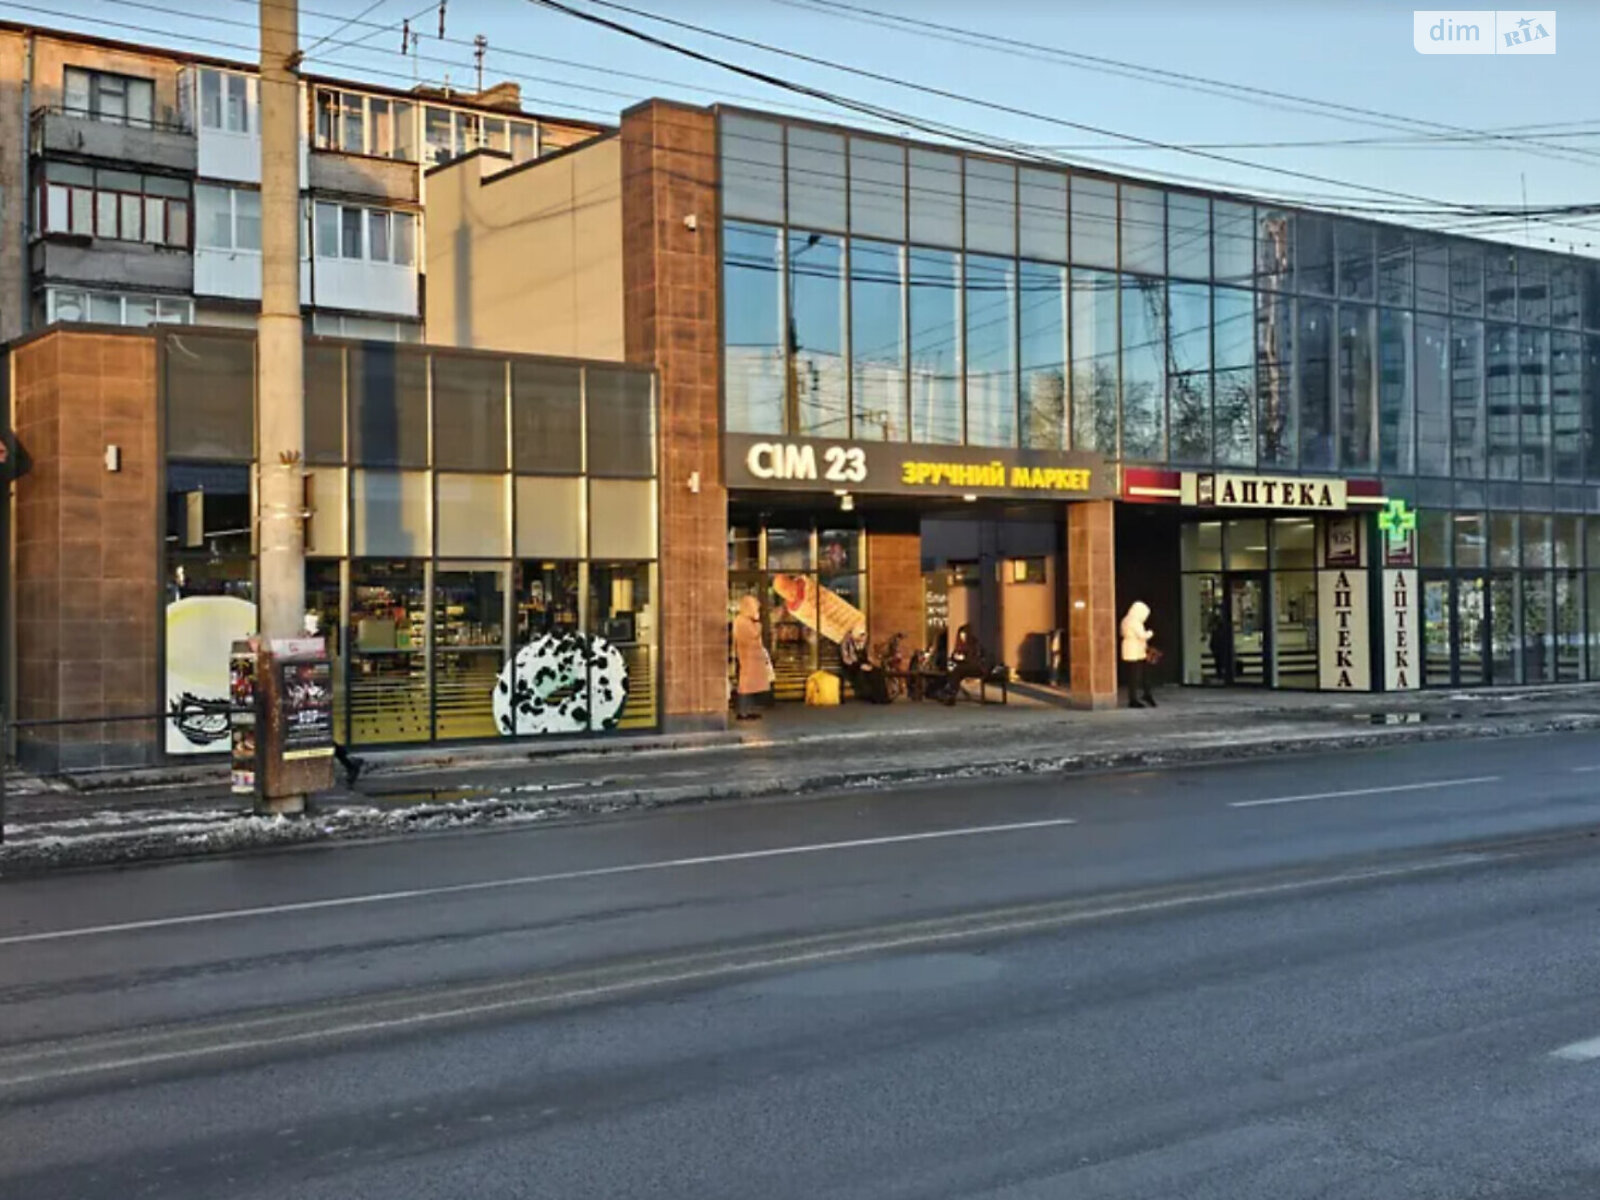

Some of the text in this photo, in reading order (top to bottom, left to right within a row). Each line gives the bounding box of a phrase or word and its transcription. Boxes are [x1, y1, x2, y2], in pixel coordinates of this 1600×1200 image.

[747, 442, 868, 483] СІМ 23
[902, 460, 1092, 491] ЗРУЧНИЙ МАРКЕТ
[1222, 478, 1334, 507] АПТЕКА
[1334, 570, 1353, 688] АПТЕКА
[1393, 570, 1409, 688] АПТЕКА
